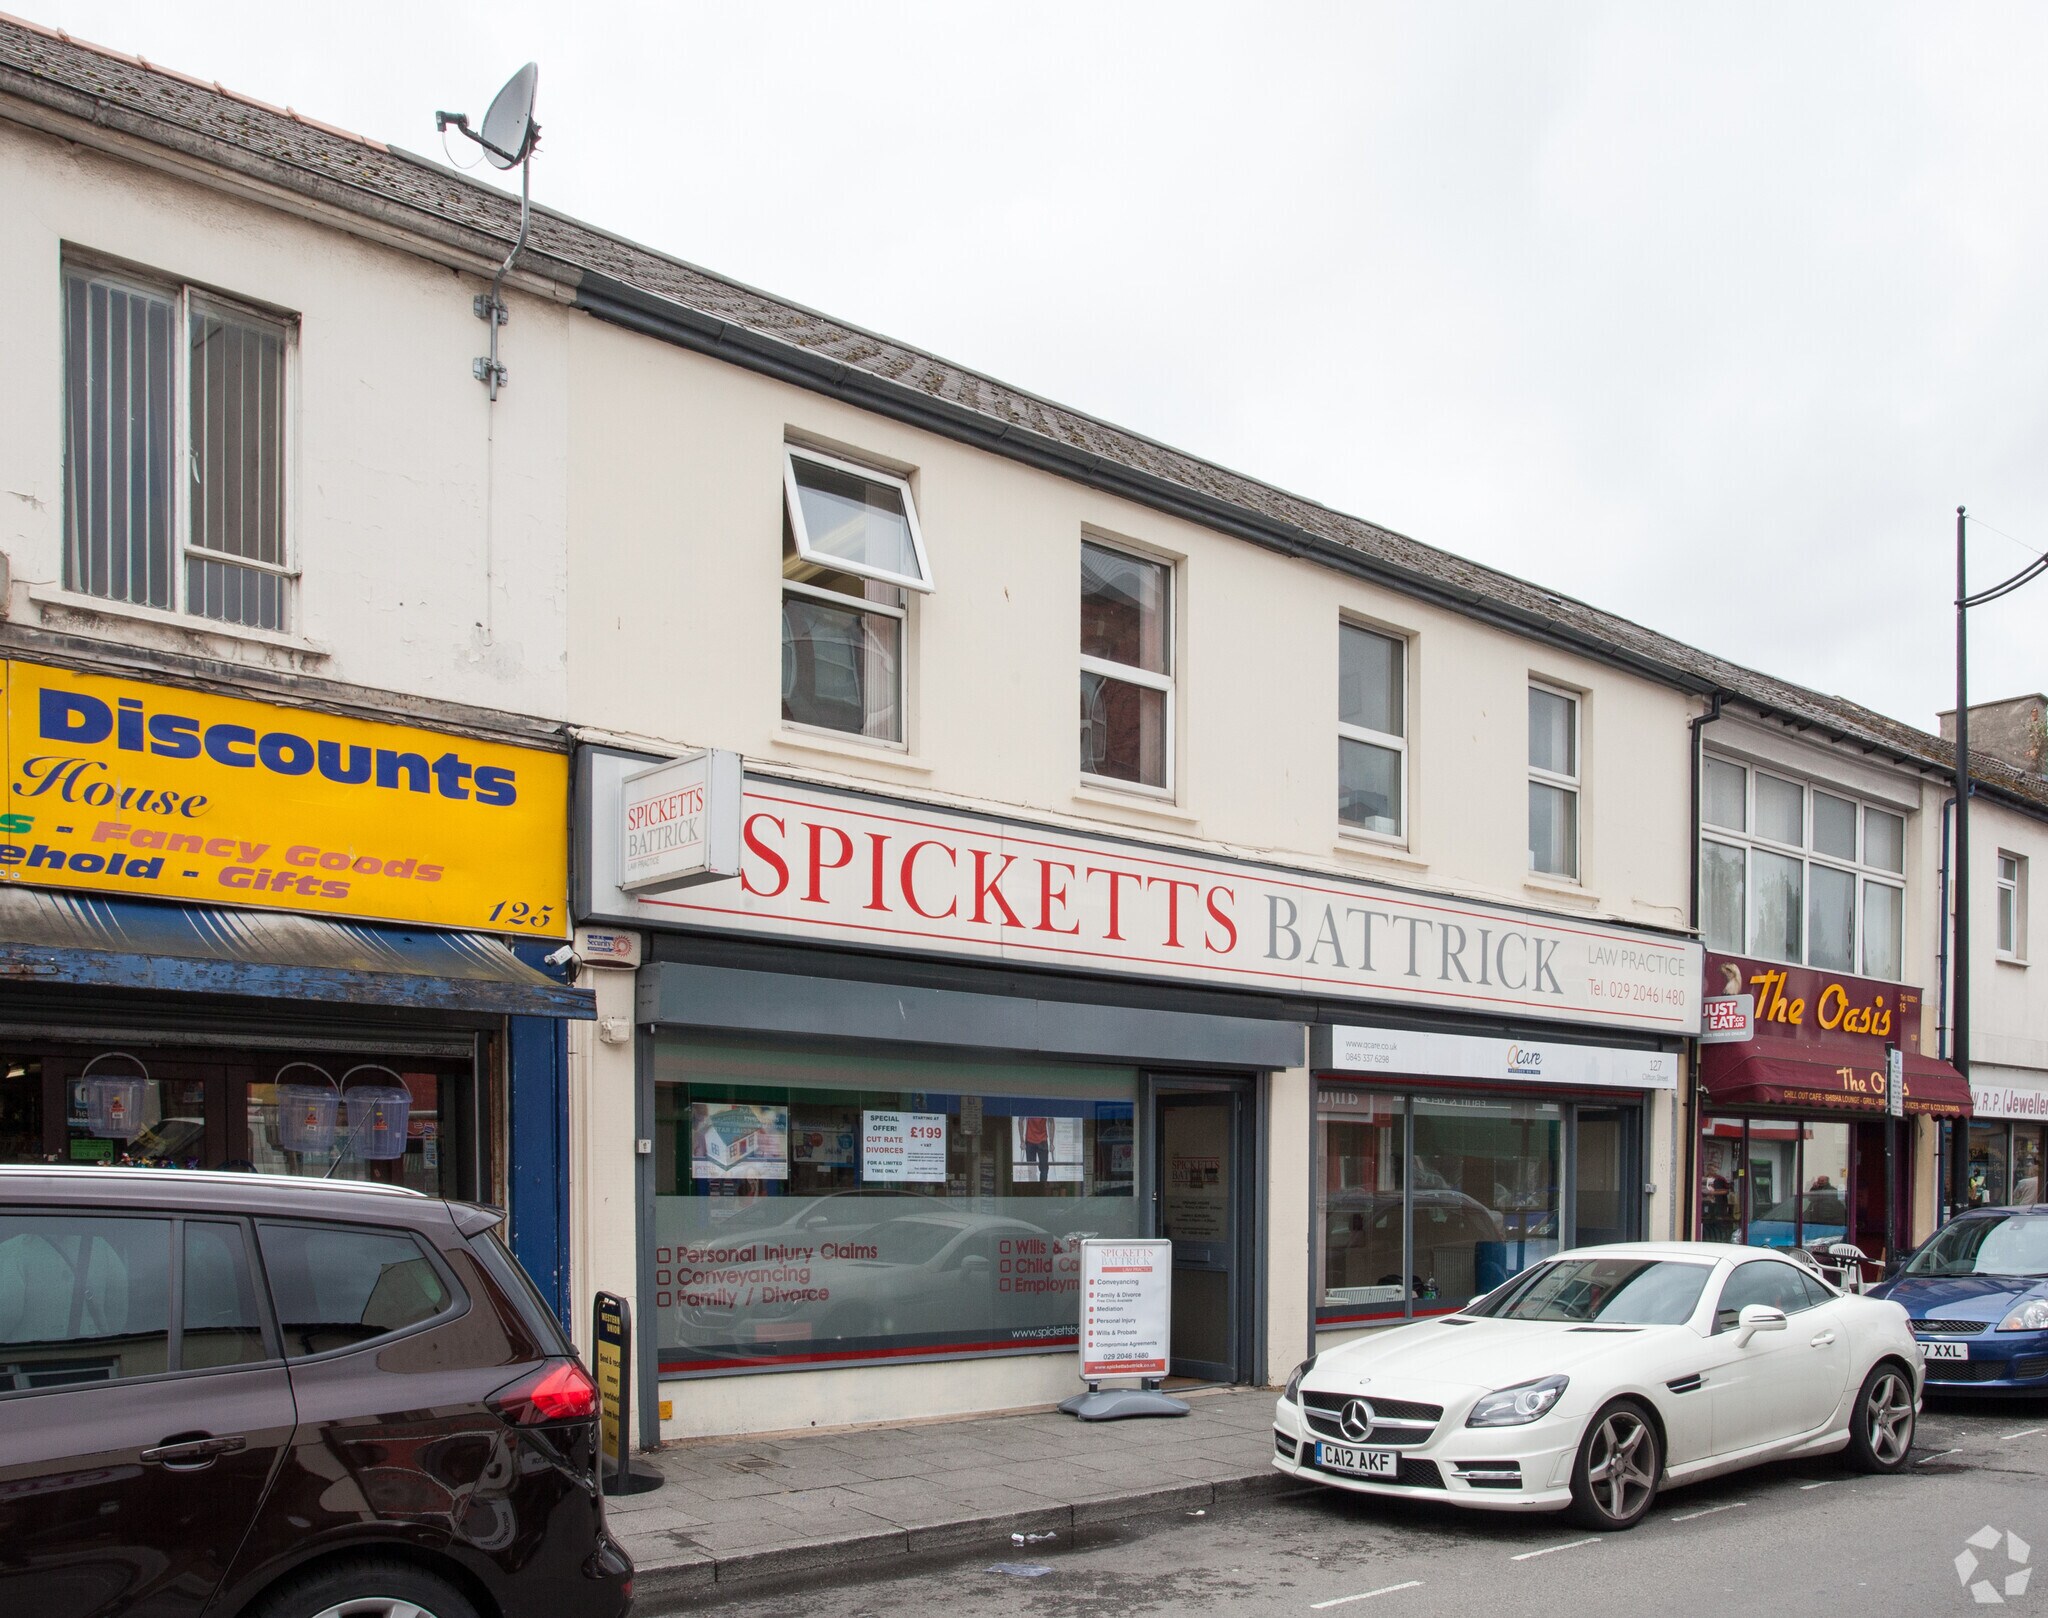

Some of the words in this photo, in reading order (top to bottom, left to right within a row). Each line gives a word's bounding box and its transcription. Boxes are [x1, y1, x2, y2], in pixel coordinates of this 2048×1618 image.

[39, 688, 517, 806] Discounts
[12, 756, 214, 818] House
[628, 787, 704, 831] SPICKETTS
[628, 817, 698, 858] BATTRICK
[91, 821, 270, 864] Fancy
[285, 845, 444, 882] Goods
[218, 866, 351, 899] Gifts
[488, 900, 554, 928] 125
[740, 812, 1238, 954] SPICKETTS
[1263, 894, 1564, 995] BATTRICK
[1588, 945, 1618, 966] LAW
[1621, 950, 1685, 977] PRACTICE
[1588, 978, 1607, 997] Tel.
[1610, 981, 1630, 999] 029
[1703, 1002, 1737, 1017] JUST
[1750, 969, 1805, 1025] The
[1817, 984, 1892, 1036] Oasis
[1710, 1016, 1736, 1029] EAT
[1345, 1040, 1397, 1051] www.qcare.co.uk
[1345, 1052, 1361, 1062] 0845
[1363, 1053, 1373, 1063] 337
[1649, 1060, 1662, 1071] 127
[1836, 1066, 1867, 1092] The
[1783, 1089, 1797, 1099] CHILL
[1798, 1091, 1808, 1100] OUT
[1808, 1092, 1822, 1101] CAFE
[870, 1114, 900, 1122] SPECIAL
[910, 1126, 942, 1139] £199
[677, 1245, 757, 1263] Personal
[764, 1244, 813, 1264] Injury
[821, 1243, 878, 1260] Claims
[1015, 1240, 1047, 1254] Wills
[1053, 1242, 1063, 1255] &
[1101, 1248, 1154, 1257] SPICKETTS
[1016, 1257, 1053, 1273] Child
[1059, 1258, 1079, 1272] Ca
[1101, 1257, 1150, 1265] BATTRICK
[677, 1265, 811, 1287] Conveyancing
[1015, 1276, 1080, 1294] Employm
[677, 1288, 738, 1308] Family
[762, 1286, 830, 1303] Divorce
[1012, 1325, 1080, 1338] www.spickettsba
[1934, 1344, 1962, 1358] XXL
[1325, 1446, 1354, 1468] CA12
[1360, 1452, 1389, 1472] AKF
